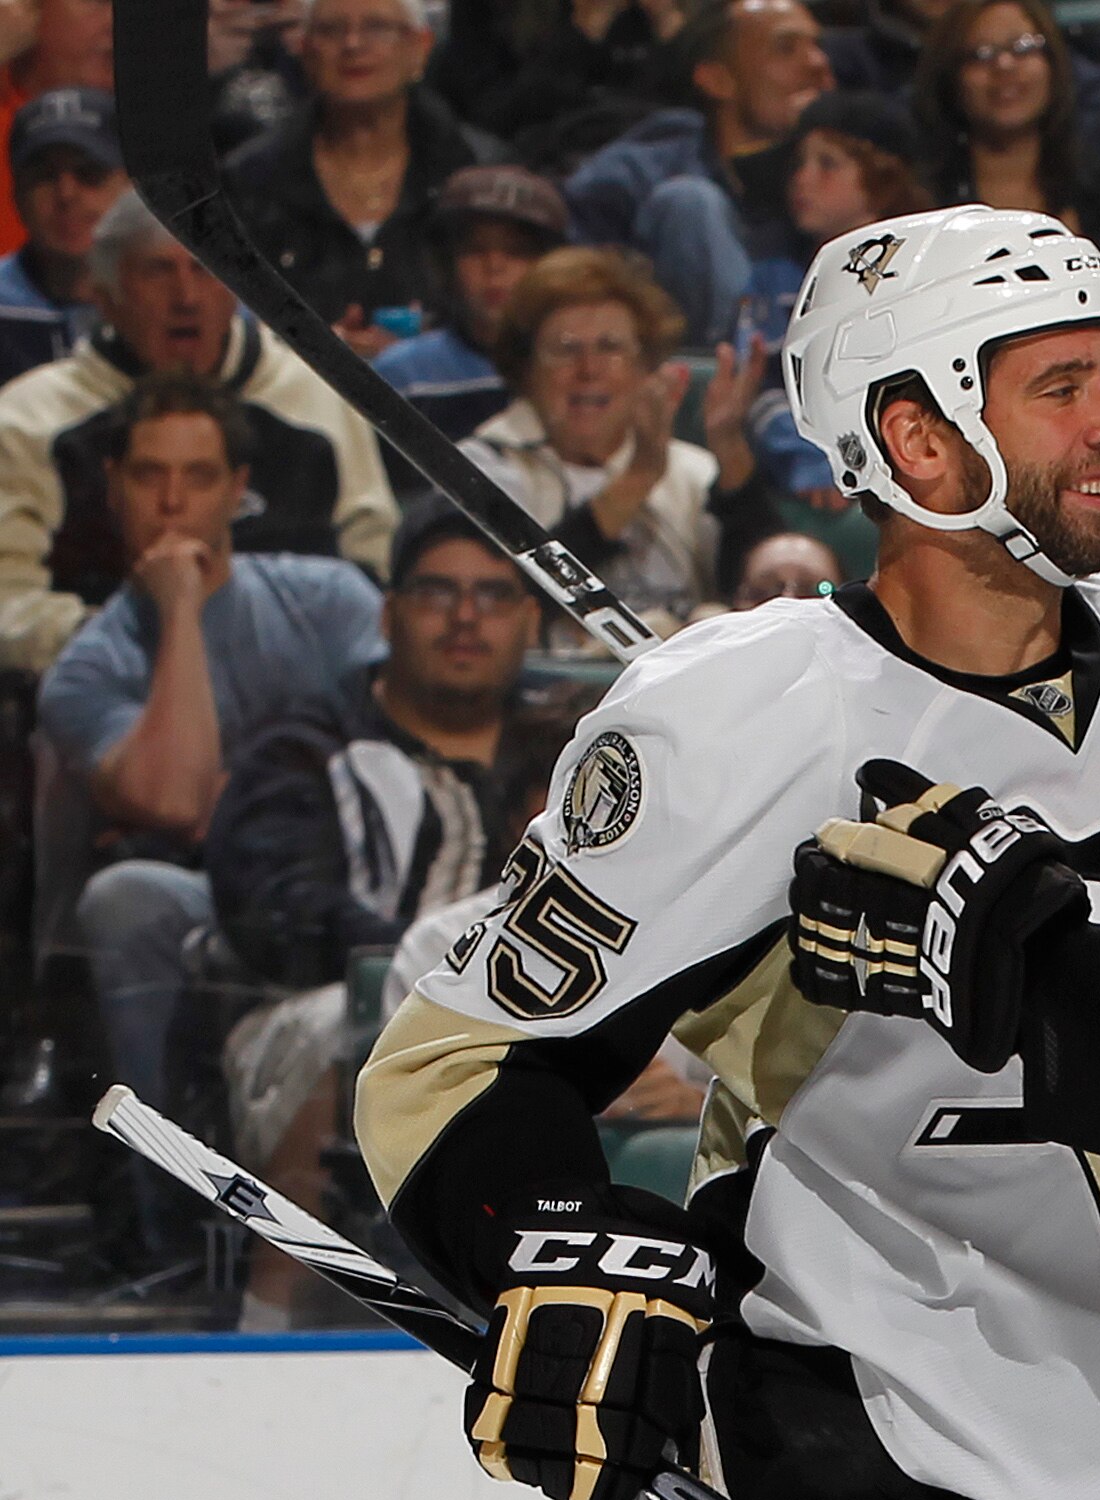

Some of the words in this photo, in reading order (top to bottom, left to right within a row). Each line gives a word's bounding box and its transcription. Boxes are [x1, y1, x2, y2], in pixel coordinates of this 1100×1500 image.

[625, 752, 641, 814] SEASON
[598, 821, 627, 844] 2011
[536, 1199, 583, 1213] TALBOT
[507, 1229, 717, 1299] CCM
